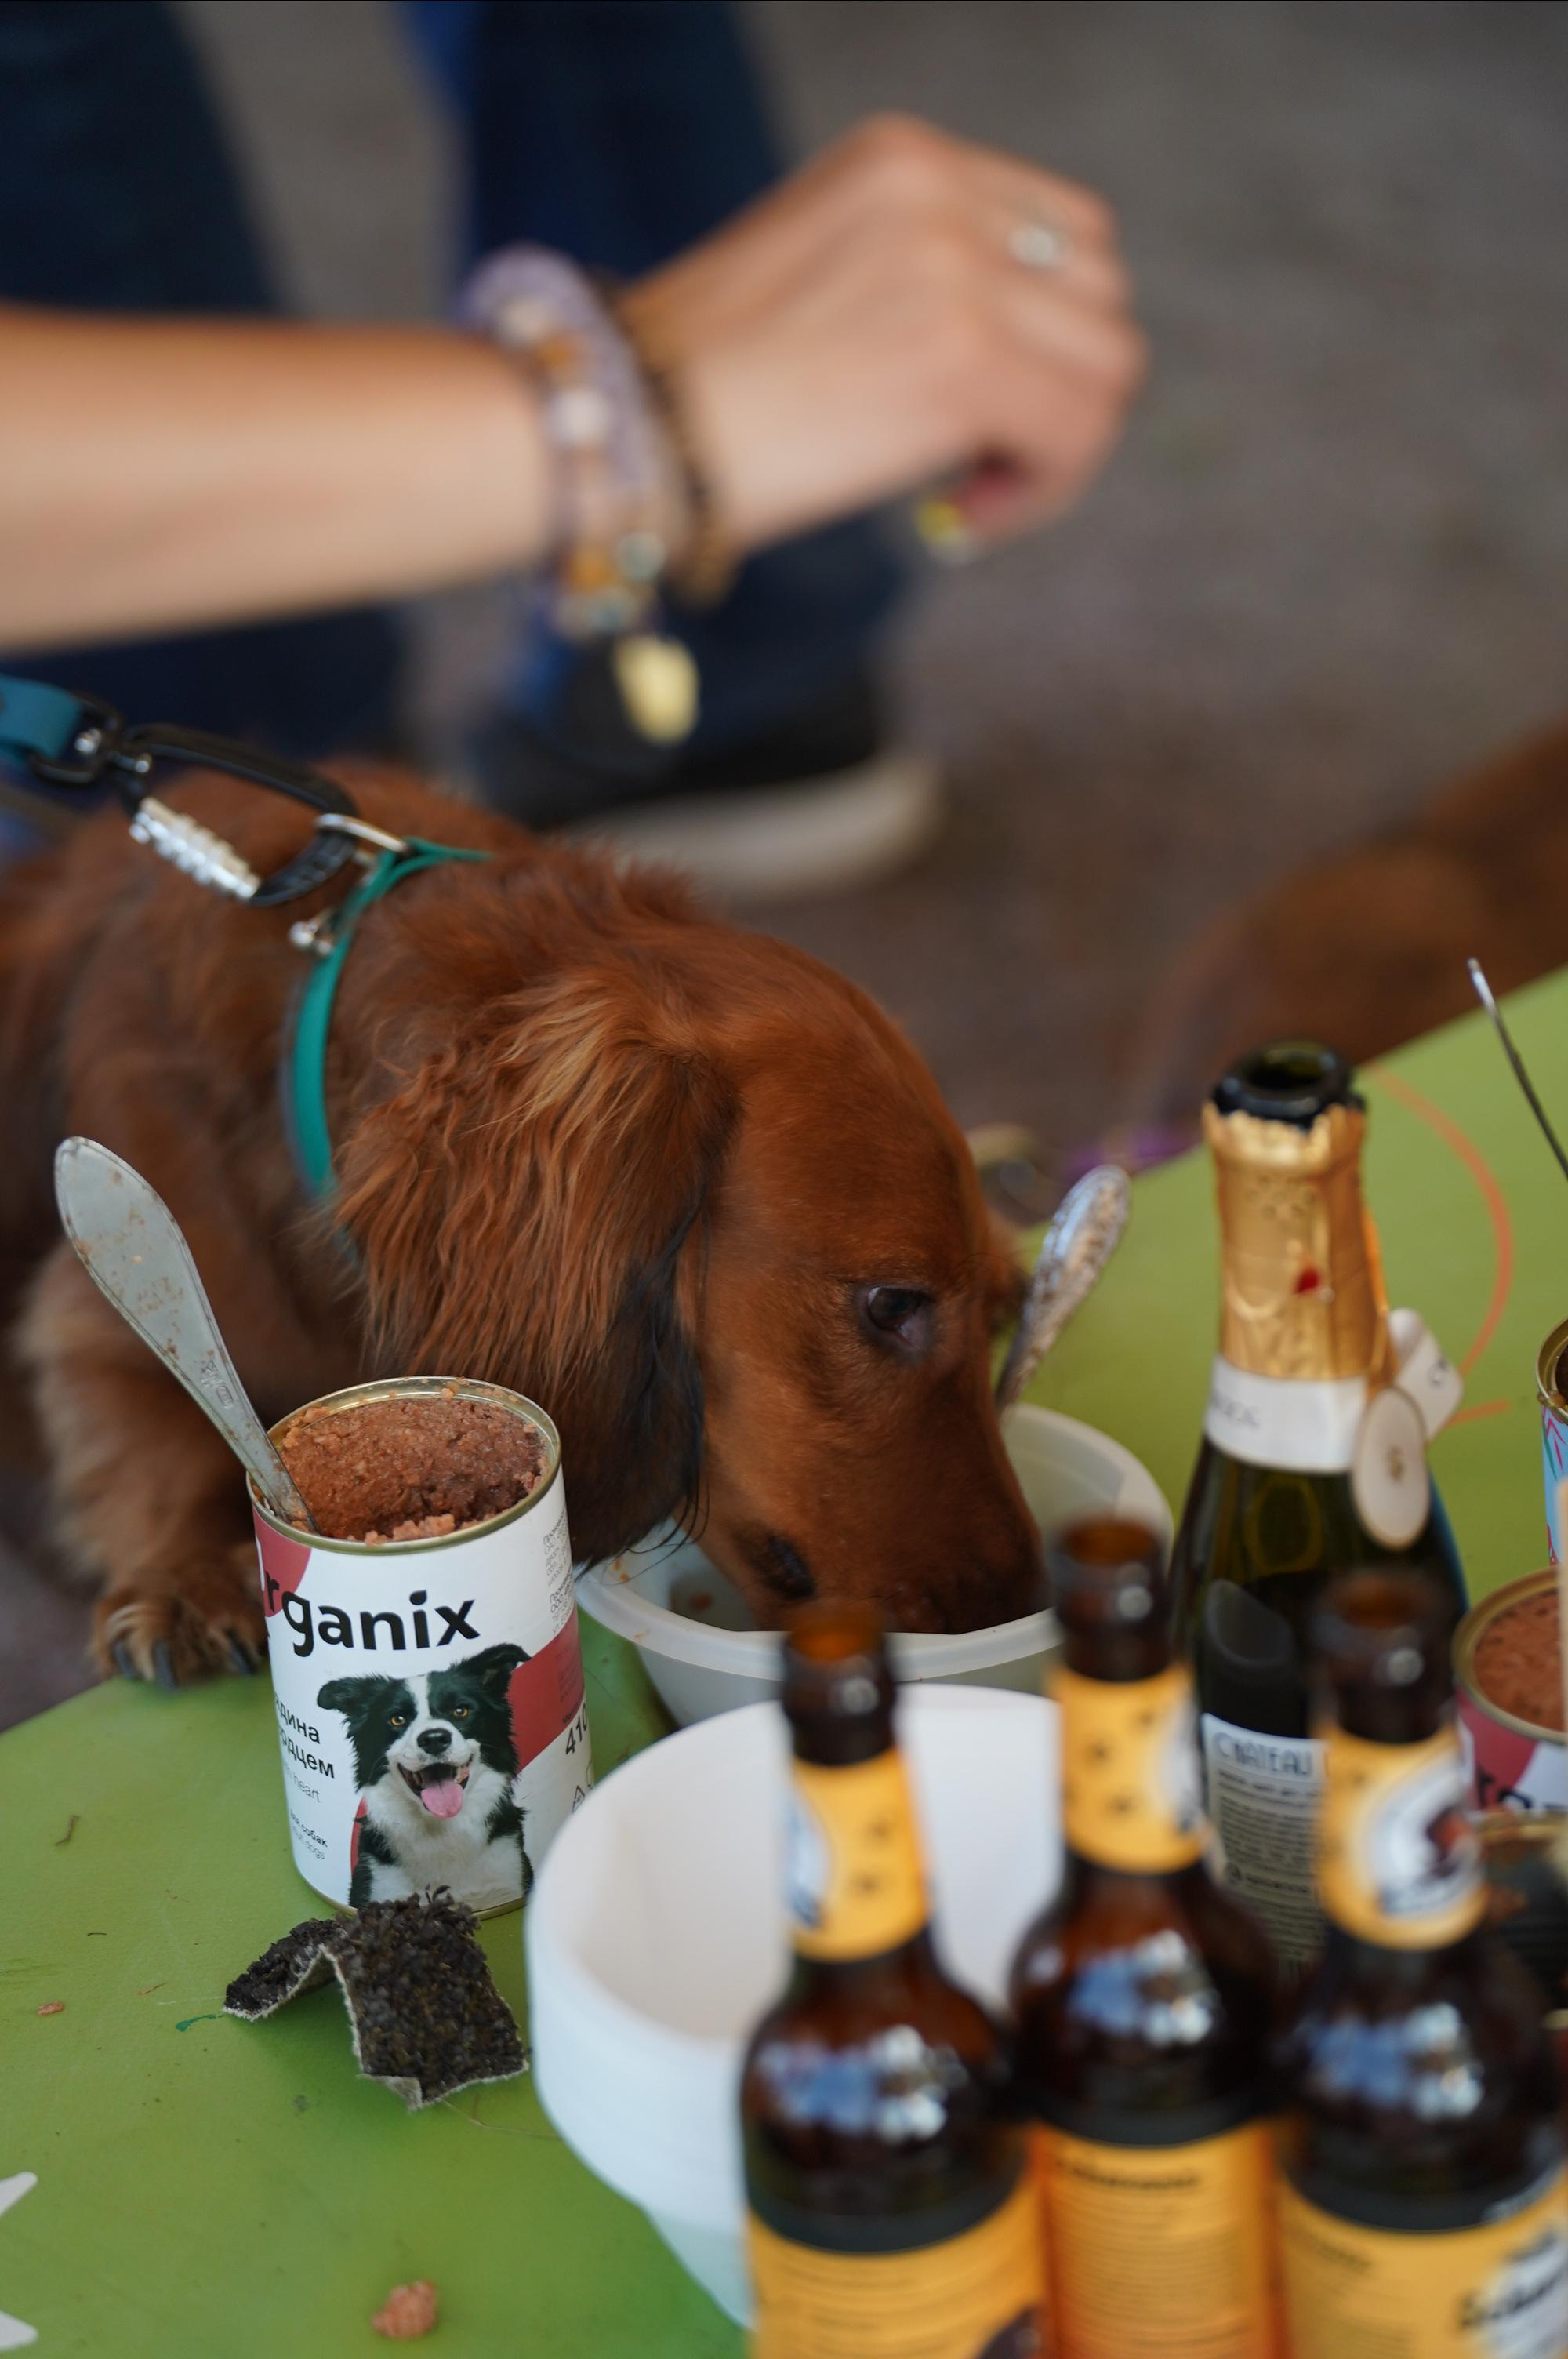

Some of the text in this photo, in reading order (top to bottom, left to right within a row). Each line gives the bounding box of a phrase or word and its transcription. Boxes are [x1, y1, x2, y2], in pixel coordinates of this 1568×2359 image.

[257, 1561, 481, 1658] rganix
[275, 1692, 321, 1745] дина
[565, 1702, 587, 1755] 410
